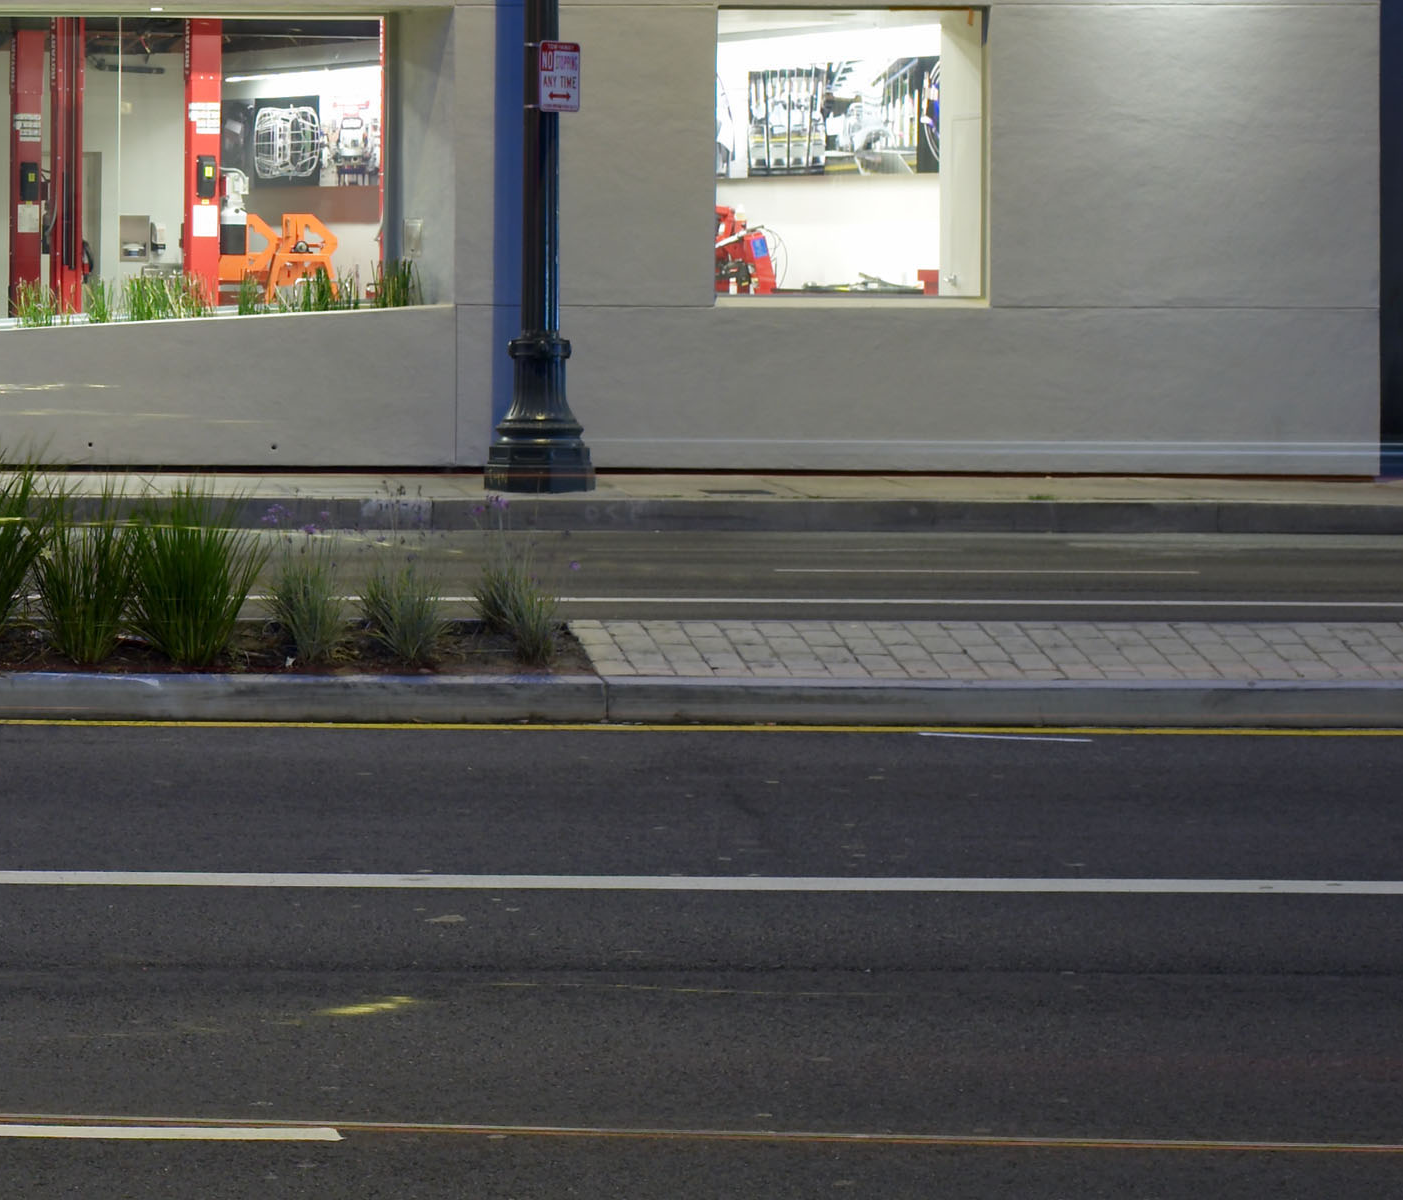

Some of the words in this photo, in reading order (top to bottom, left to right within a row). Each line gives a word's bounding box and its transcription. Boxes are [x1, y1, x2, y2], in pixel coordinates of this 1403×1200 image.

[542, 51, 554, 70] NO
[543, 75, 557, 89] ANY
[560, 76, 577, 90] TIME
